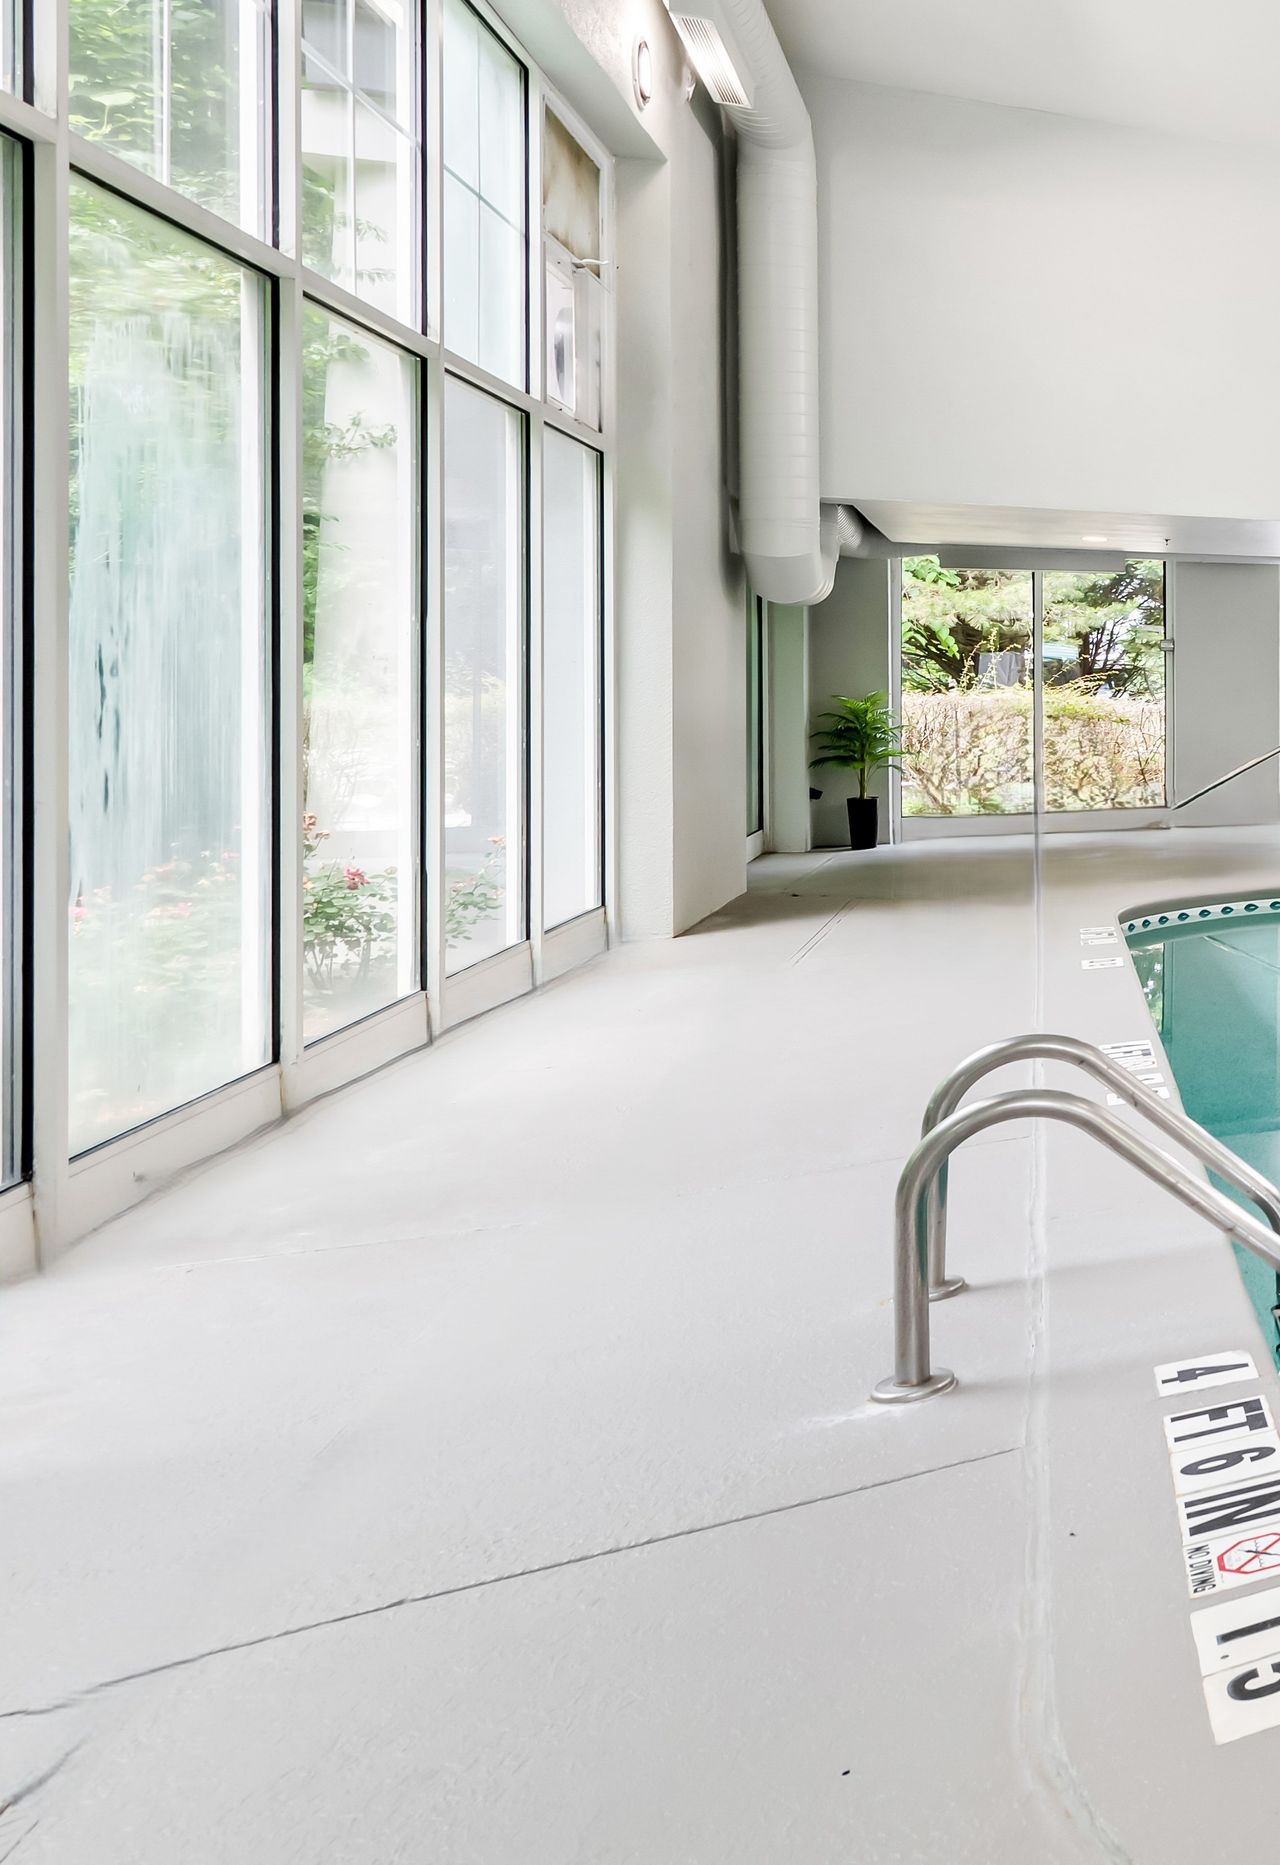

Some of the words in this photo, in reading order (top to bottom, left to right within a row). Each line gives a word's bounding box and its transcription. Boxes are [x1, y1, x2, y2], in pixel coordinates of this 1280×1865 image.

[1161, 1363, 1250, 1385] 4
[1170, 1398, 1269, 1444] FT
[1180, 1446, 1277, 1476] 6
[1187, 1544, 1211, 1560] NO
[1189, 1559, 1217, 1594] DIVING
